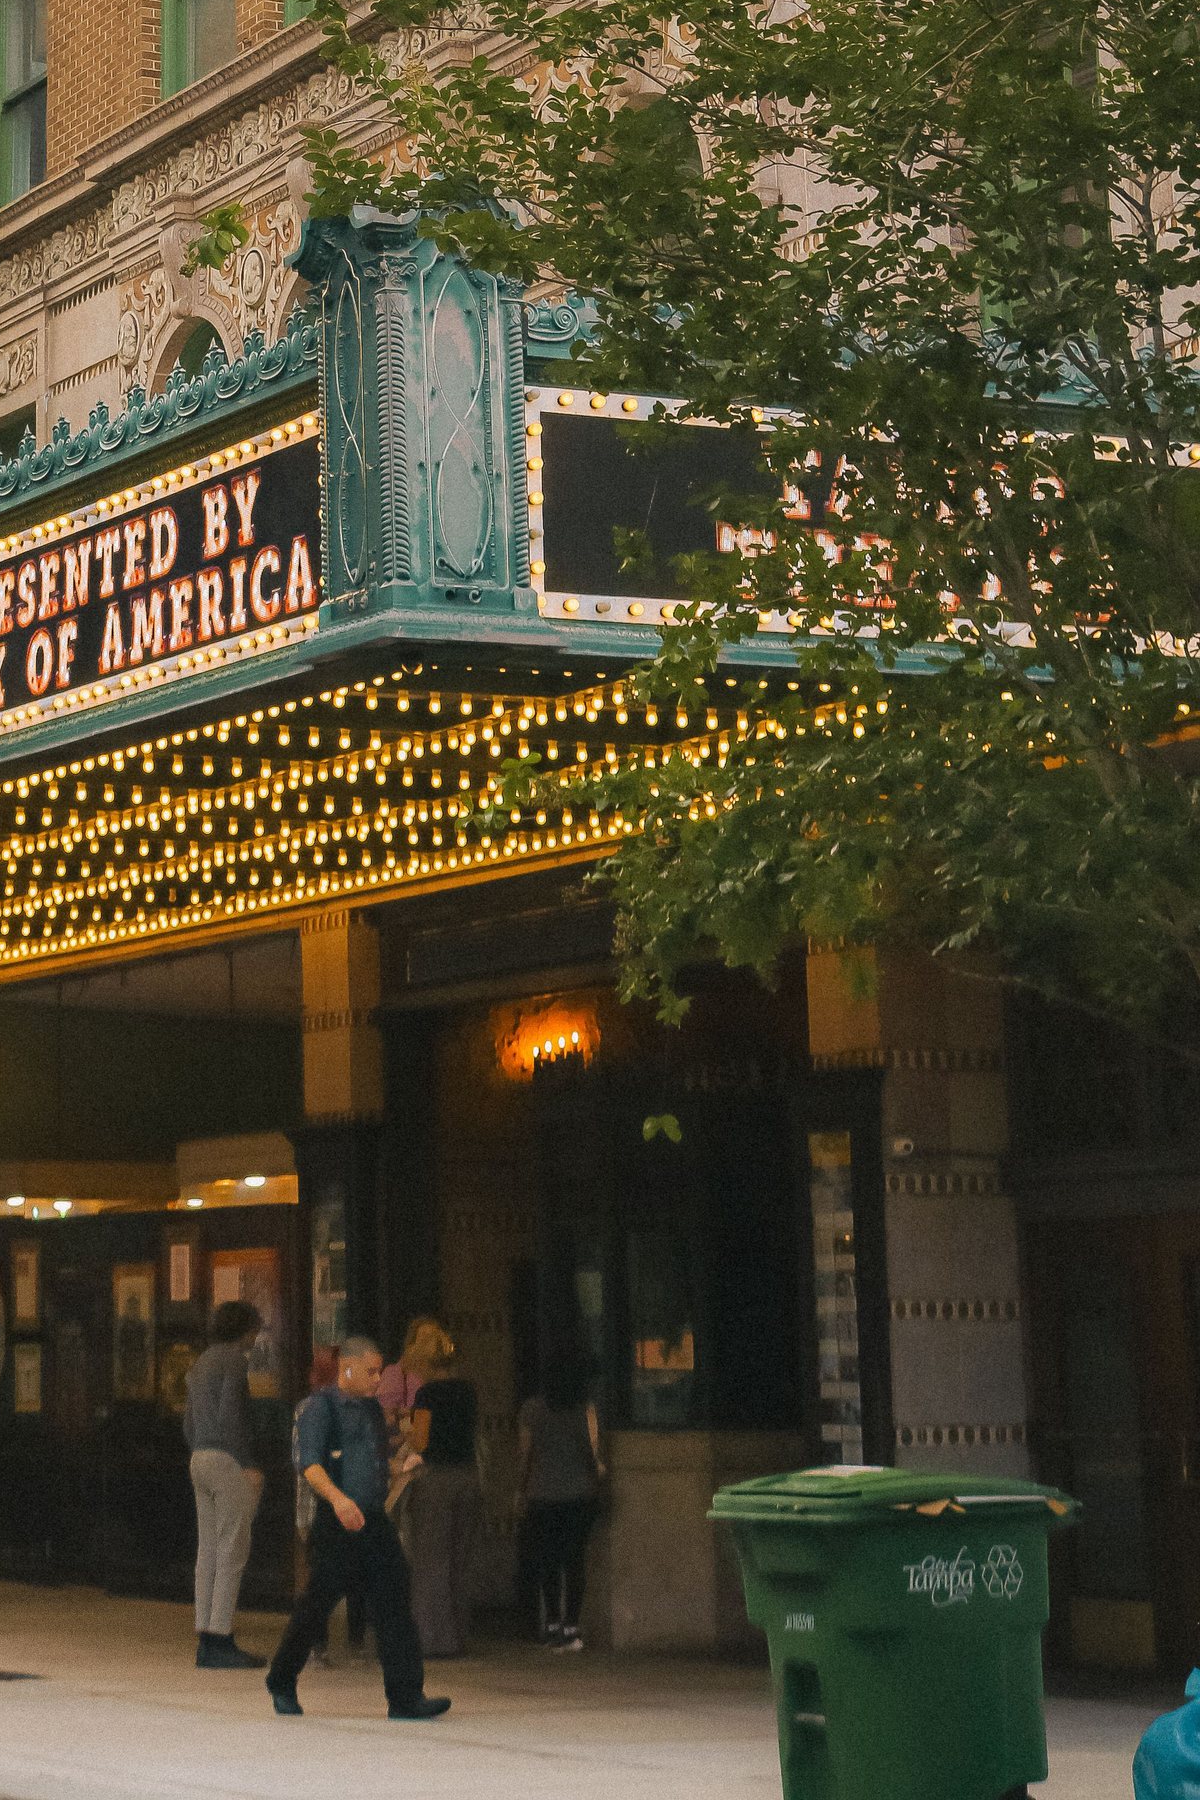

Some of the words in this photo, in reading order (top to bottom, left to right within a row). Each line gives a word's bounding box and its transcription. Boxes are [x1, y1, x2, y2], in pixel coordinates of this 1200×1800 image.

[202, 468, 262, 561] BY
[26, 616, 79, 696] OF
[98, 533, 318, 675] AMERICA
[903, 1564, 975, 1598] Tampa
